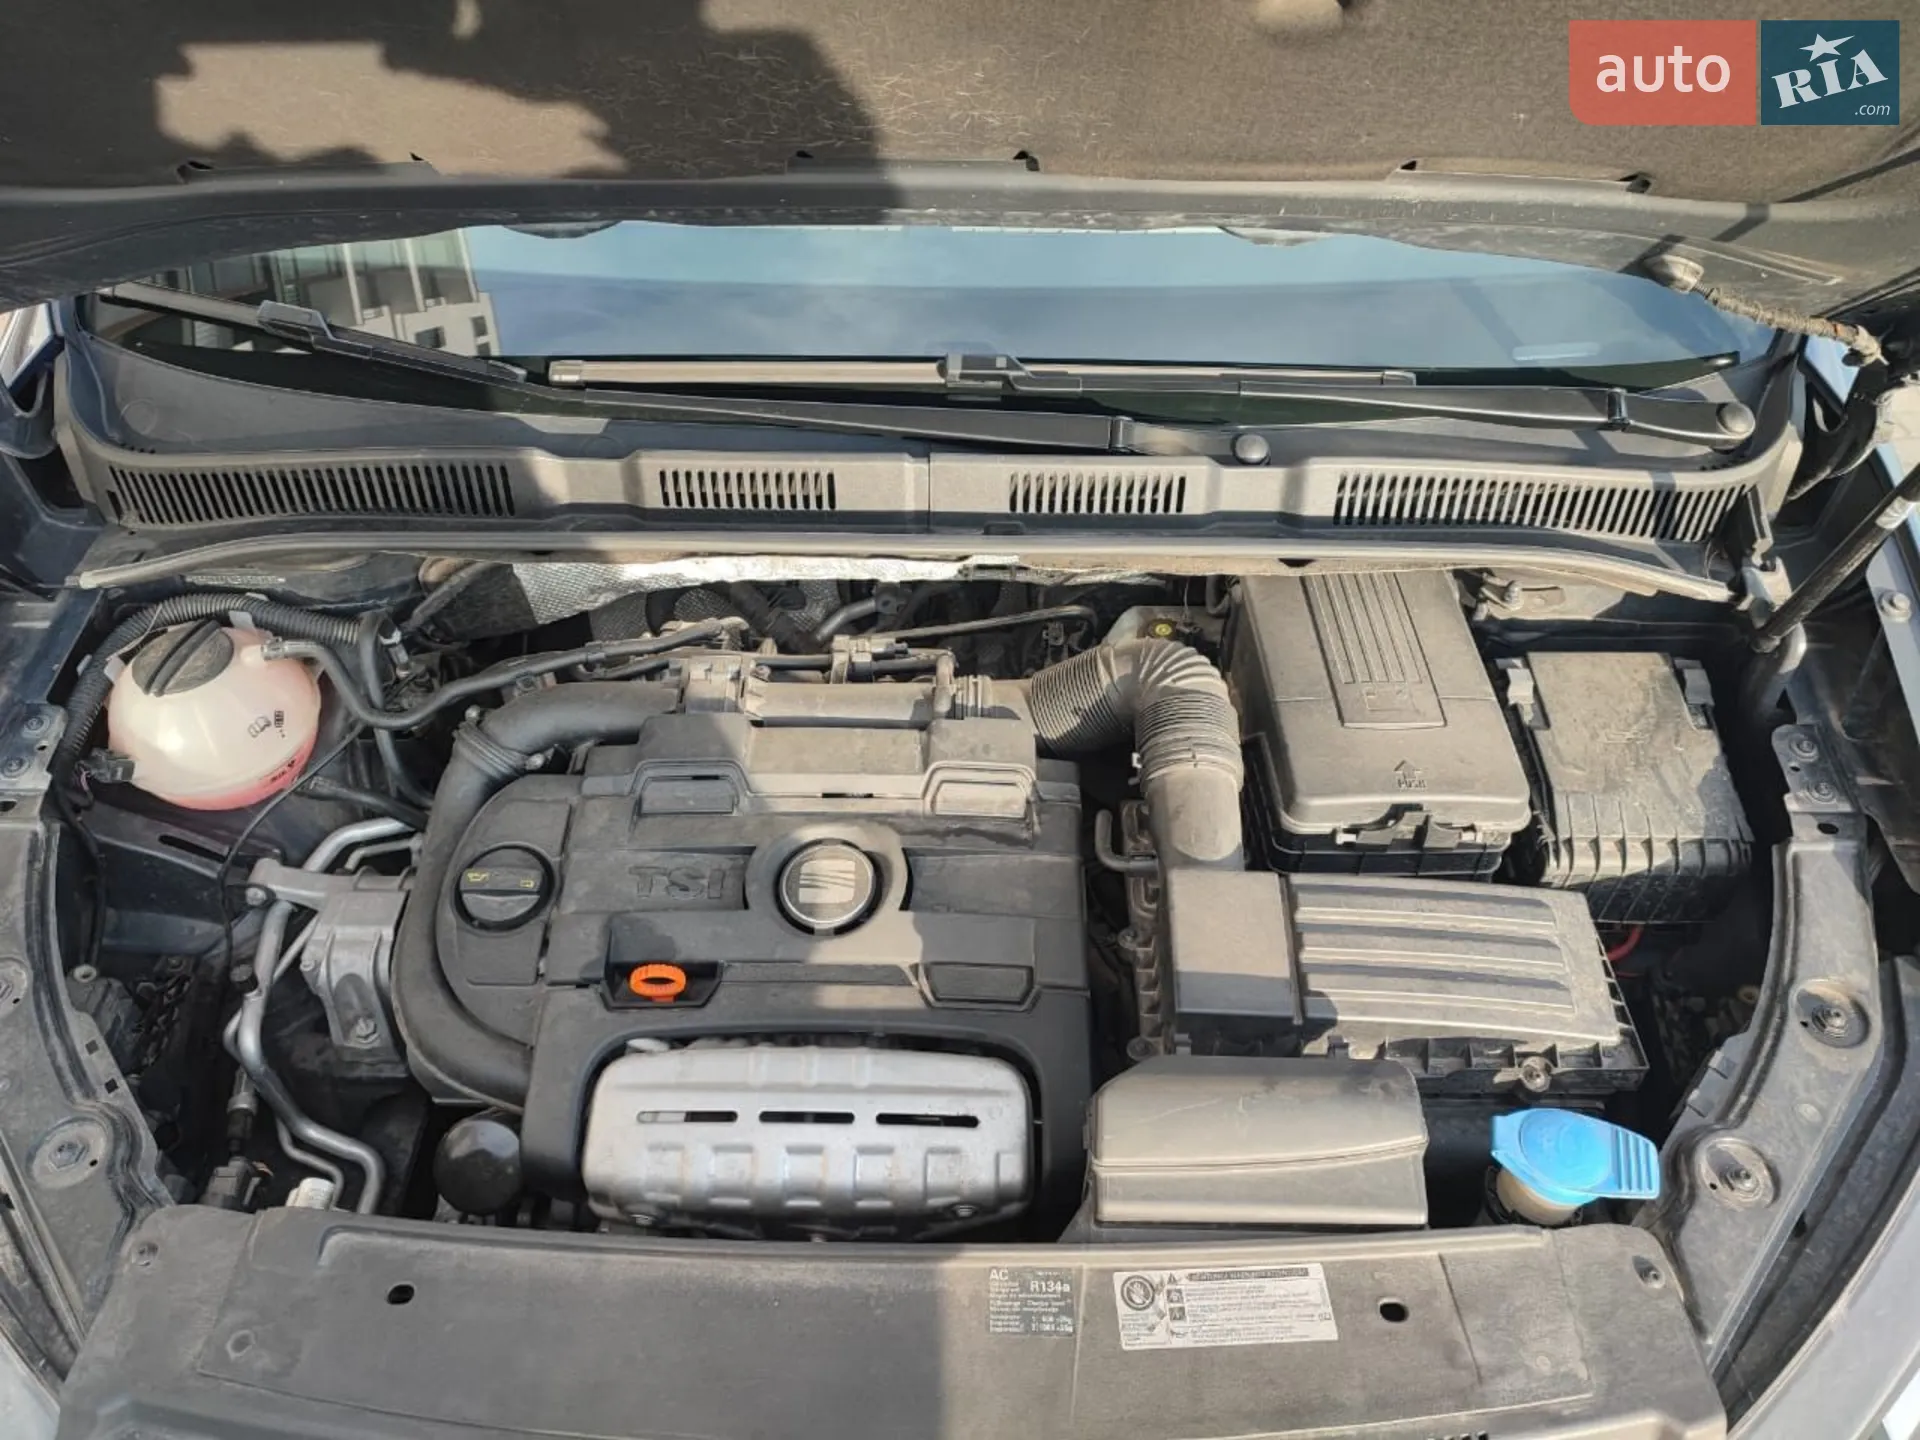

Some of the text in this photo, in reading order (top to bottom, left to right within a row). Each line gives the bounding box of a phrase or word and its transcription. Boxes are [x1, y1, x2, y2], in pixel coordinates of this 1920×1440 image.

[628, 865, 726, 899] TSI
[989, 1269, 1009, 1281] AC
[1030, 1280, 1071, 1293] R134a
